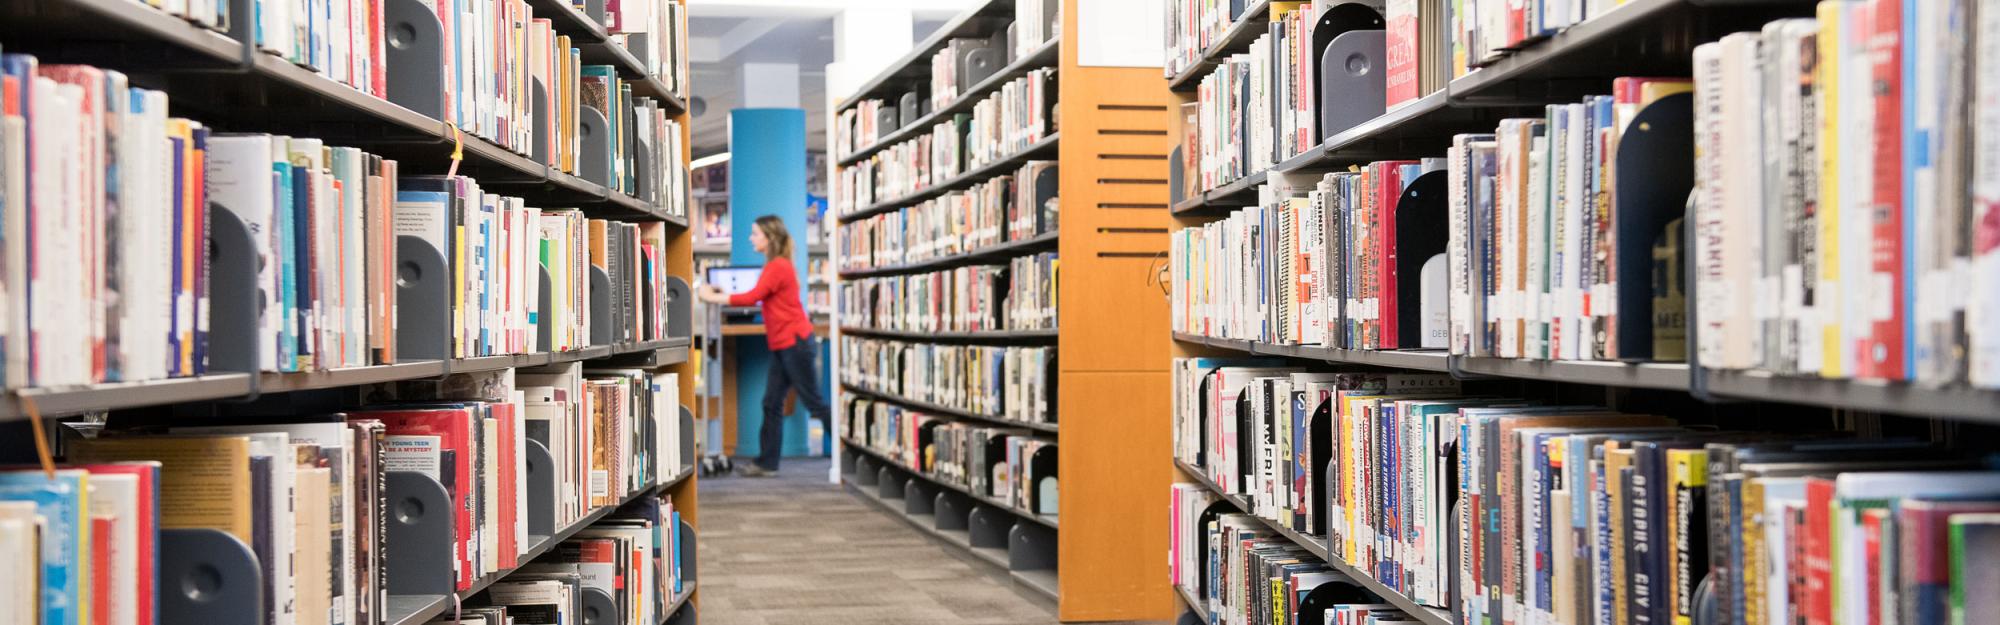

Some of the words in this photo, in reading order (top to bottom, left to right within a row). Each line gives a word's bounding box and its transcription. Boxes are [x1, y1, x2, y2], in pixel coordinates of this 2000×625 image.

[1317, 192, 1325, 246] CHINDIA
[1311, 270, 1319, 300] DOUBLE
[1631, 474, 1649, 554] OCTOPUS
